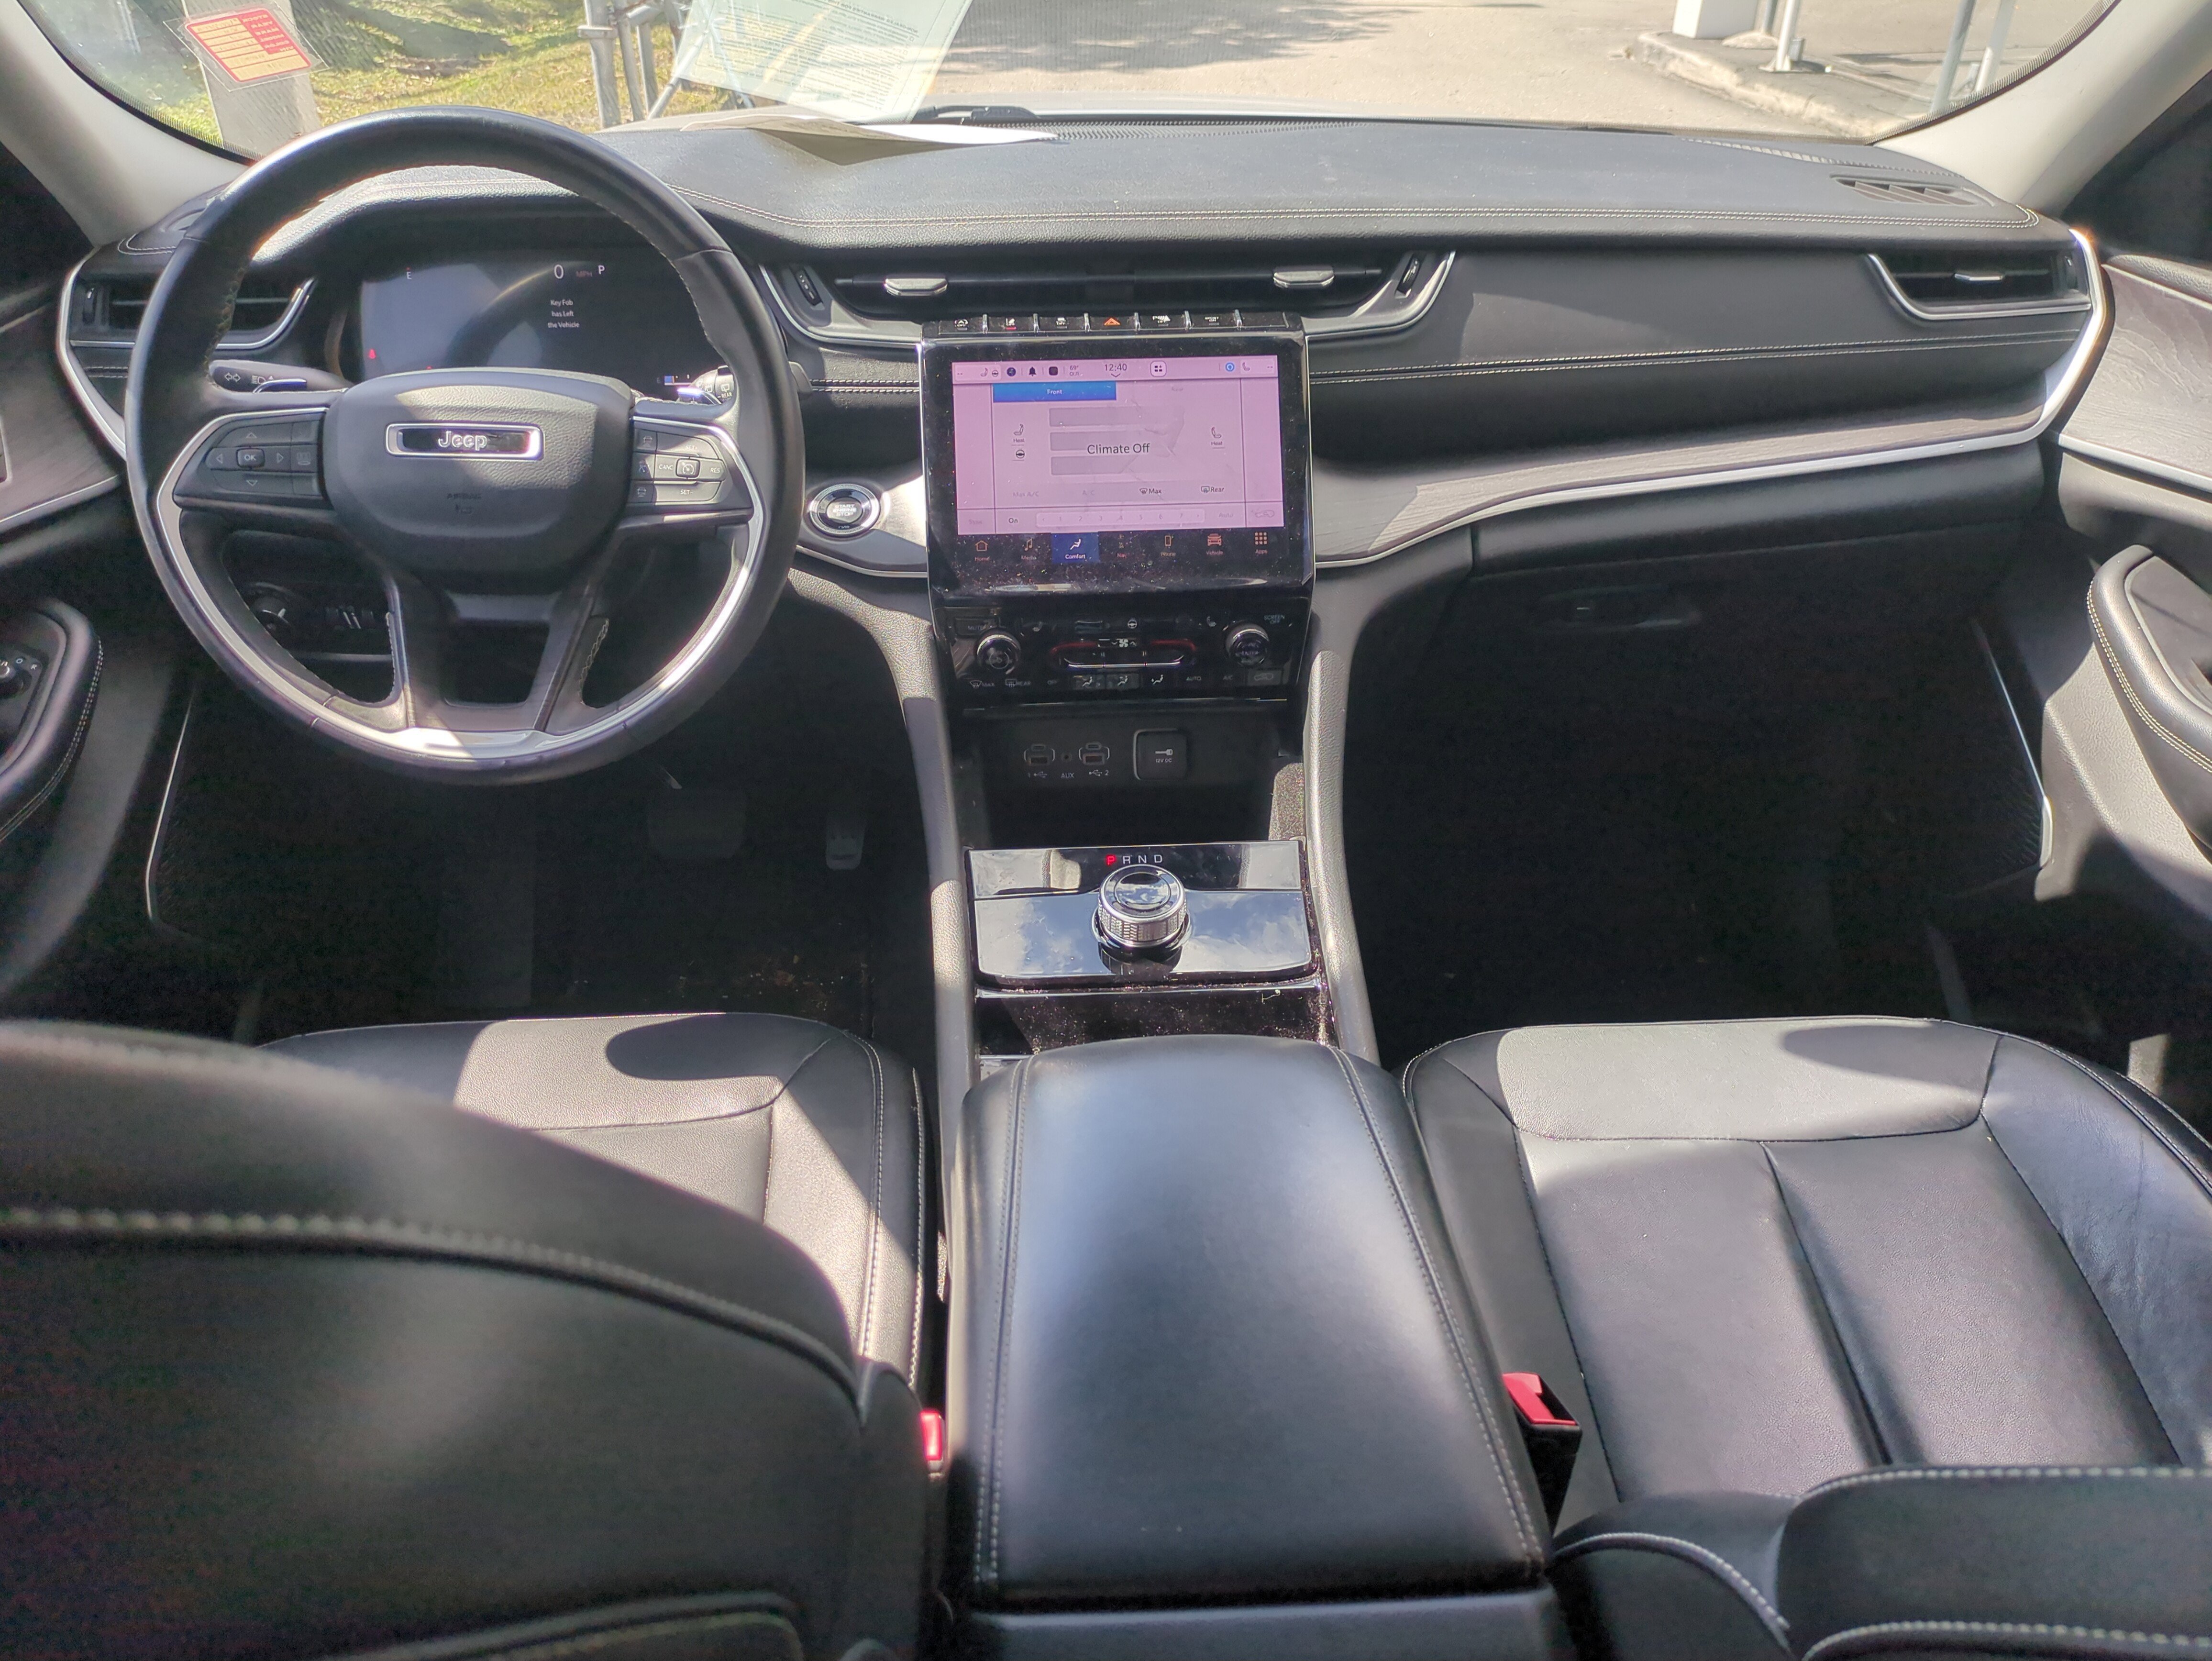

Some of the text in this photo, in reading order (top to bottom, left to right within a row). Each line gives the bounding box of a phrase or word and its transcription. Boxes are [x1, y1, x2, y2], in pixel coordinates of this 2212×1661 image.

[554, 265, 564, 278] 0
[598, 266, 605, 274] P
[1104, 364, 1127, 372] 12:40
[438, 431, 488, 451] Jeep
[1087, 443, 1150, 454] Climate Off
[1107, 854, 1162, 865] P R N D
